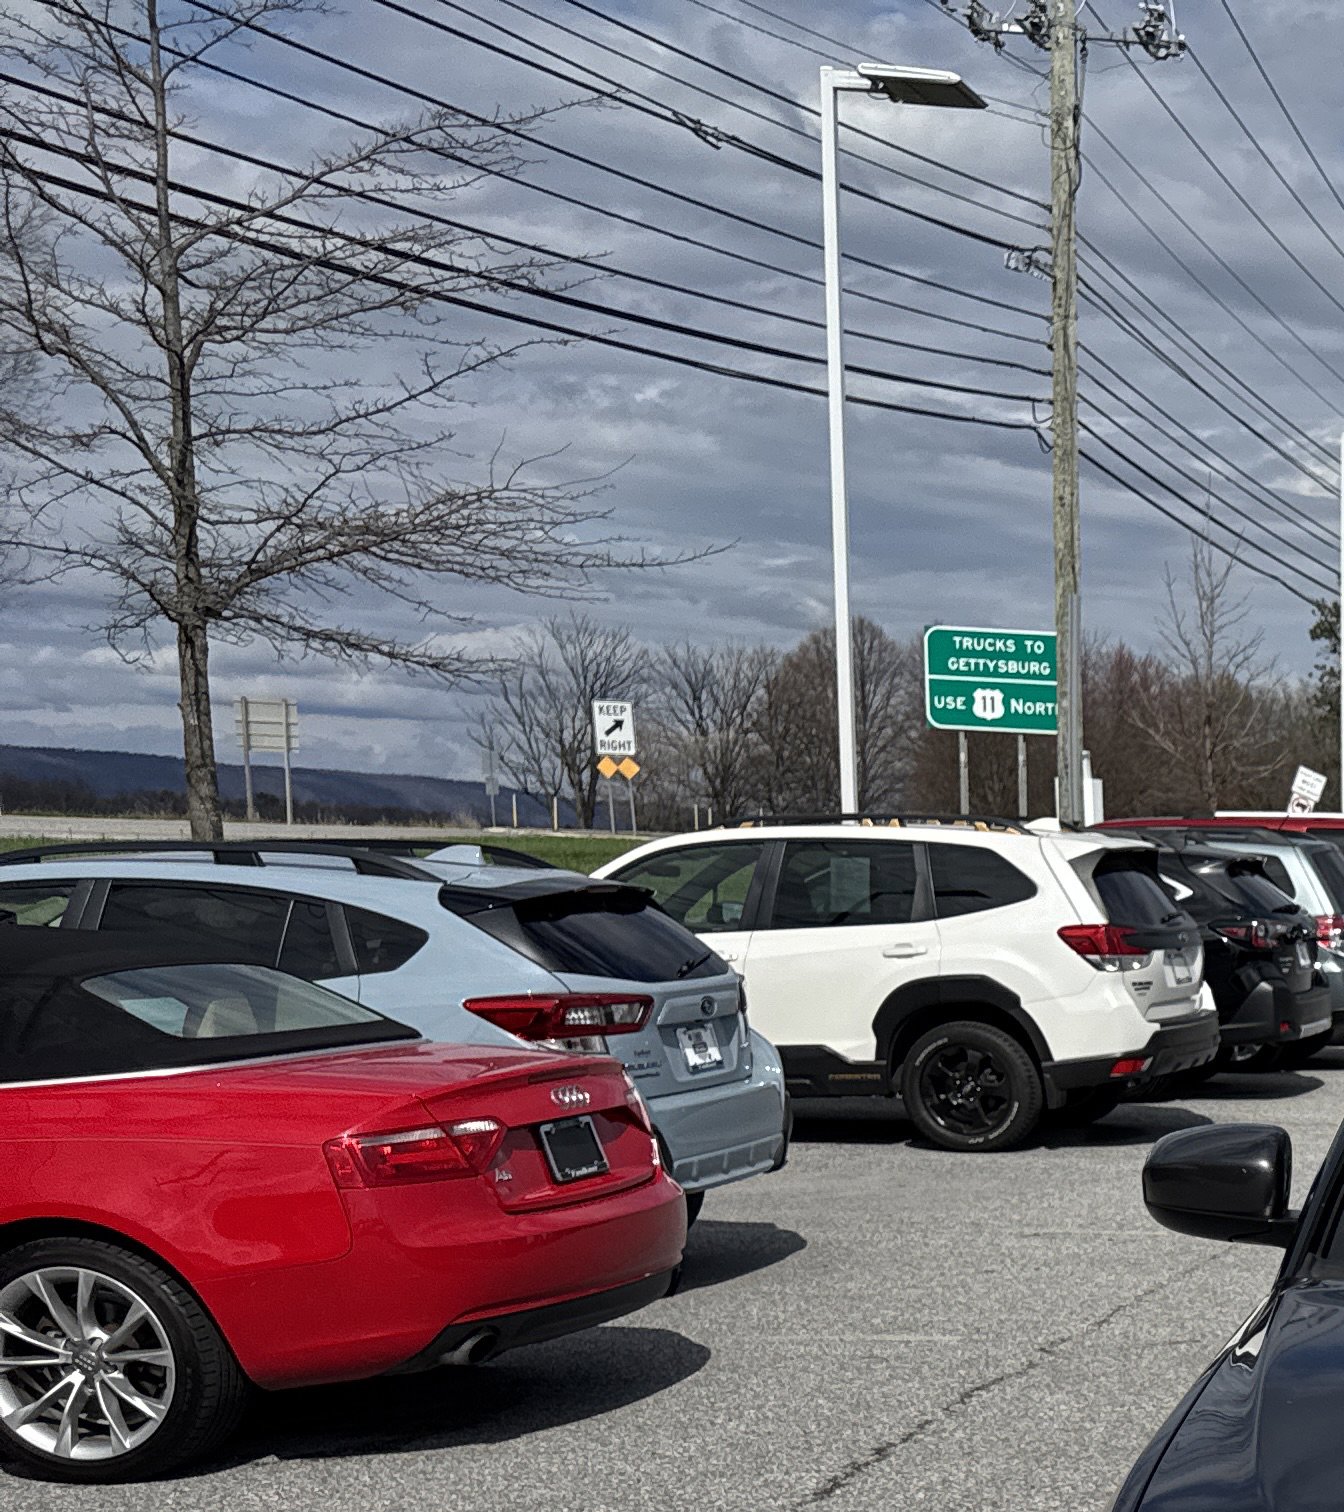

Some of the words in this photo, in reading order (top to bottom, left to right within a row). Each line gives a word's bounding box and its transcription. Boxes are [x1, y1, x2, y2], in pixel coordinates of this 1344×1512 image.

[953, 636, 1016, 653] TRUCKS
[1024, 640, 1044, 654] TO
[947, 657, 1051, 675] GETTYSBURG
[598, 704, 627, 716] KEEP
[934, 695, 966, 710] USE
[981, 695, 995, 713] 11
[600, 739, 632, 751] RIGHT
